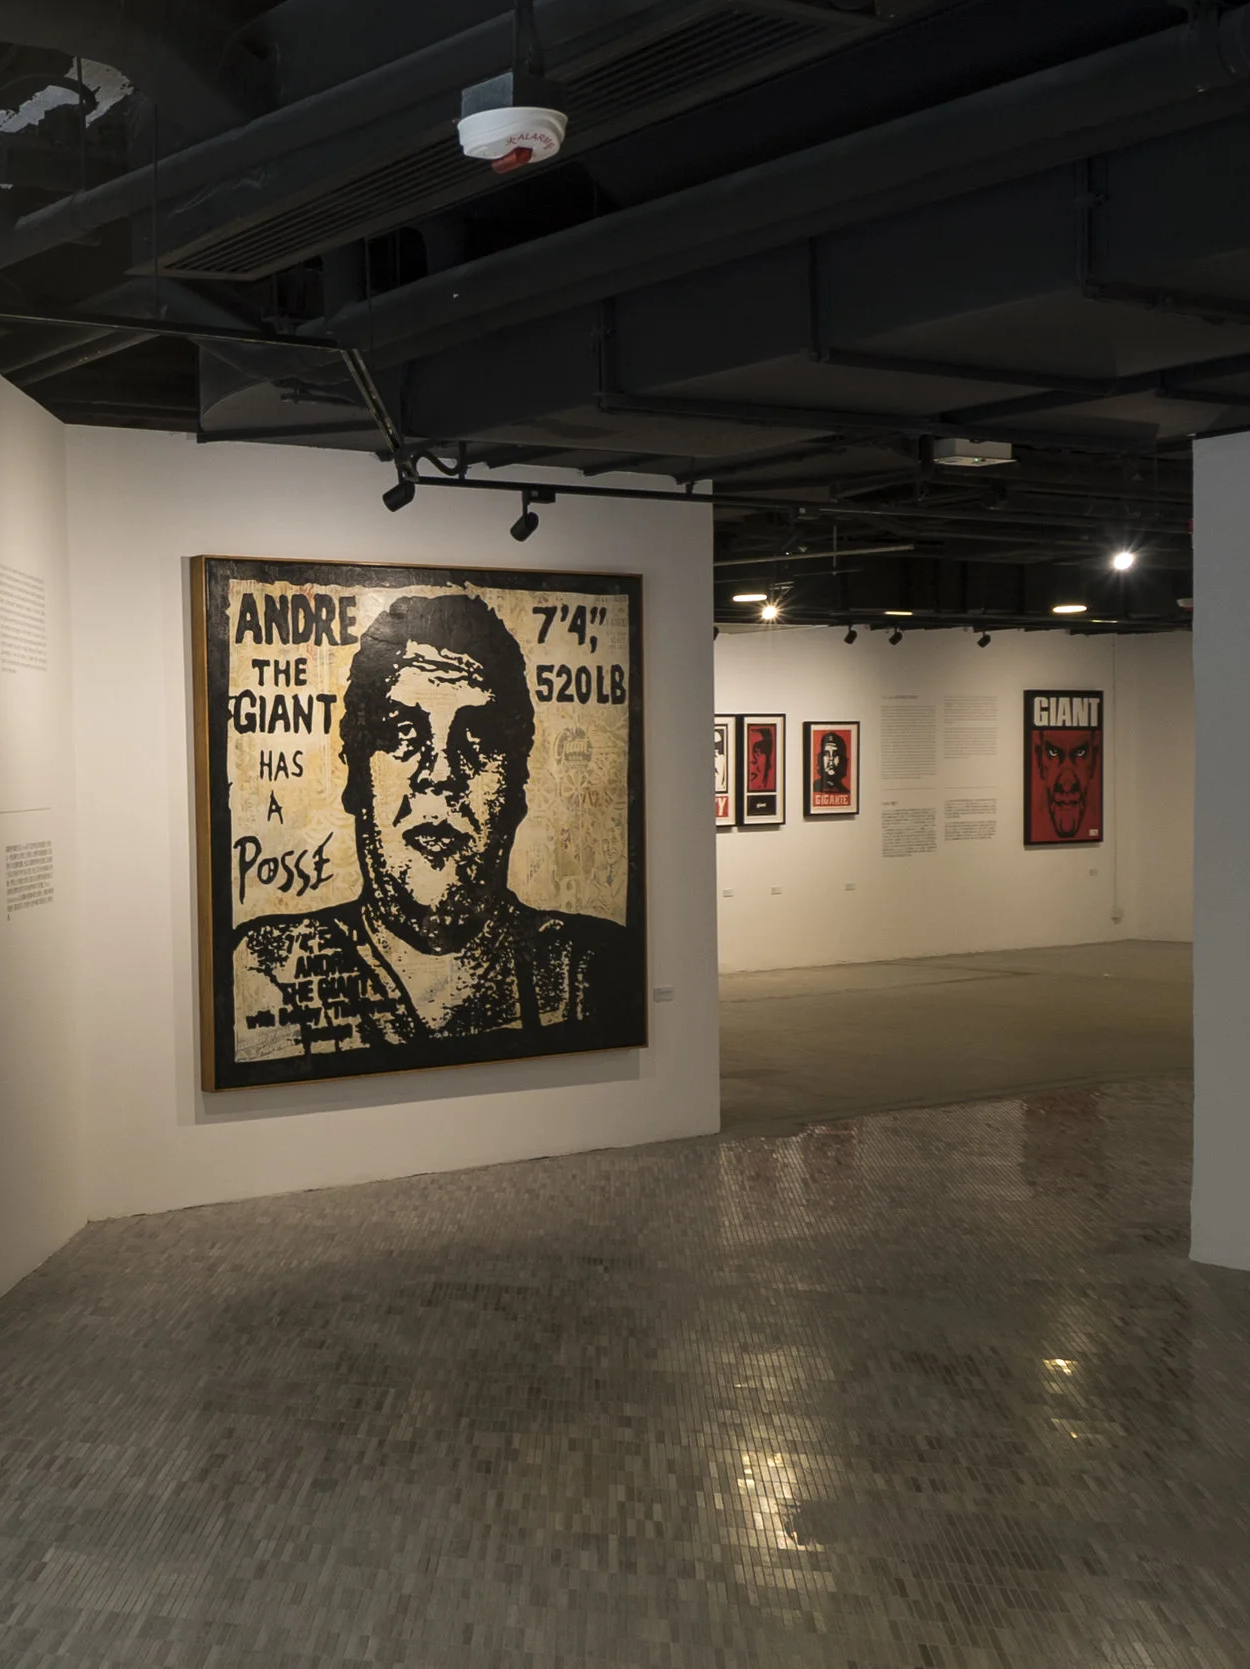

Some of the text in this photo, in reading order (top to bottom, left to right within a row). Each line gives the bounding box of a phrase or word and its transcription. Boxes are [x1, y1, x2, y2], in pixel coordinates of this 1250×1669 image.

[235, 592, 360, 647] ANDRE
[252, 659, 308, 687] THE
[232, 689, 338, 734] GIANT
[1034, 697, 1100, 727] GIANT
[259, 749, 304, 781] HAS
[267, 790, 284, 824] A
[815, 794, 848, 805] GIGANTE
